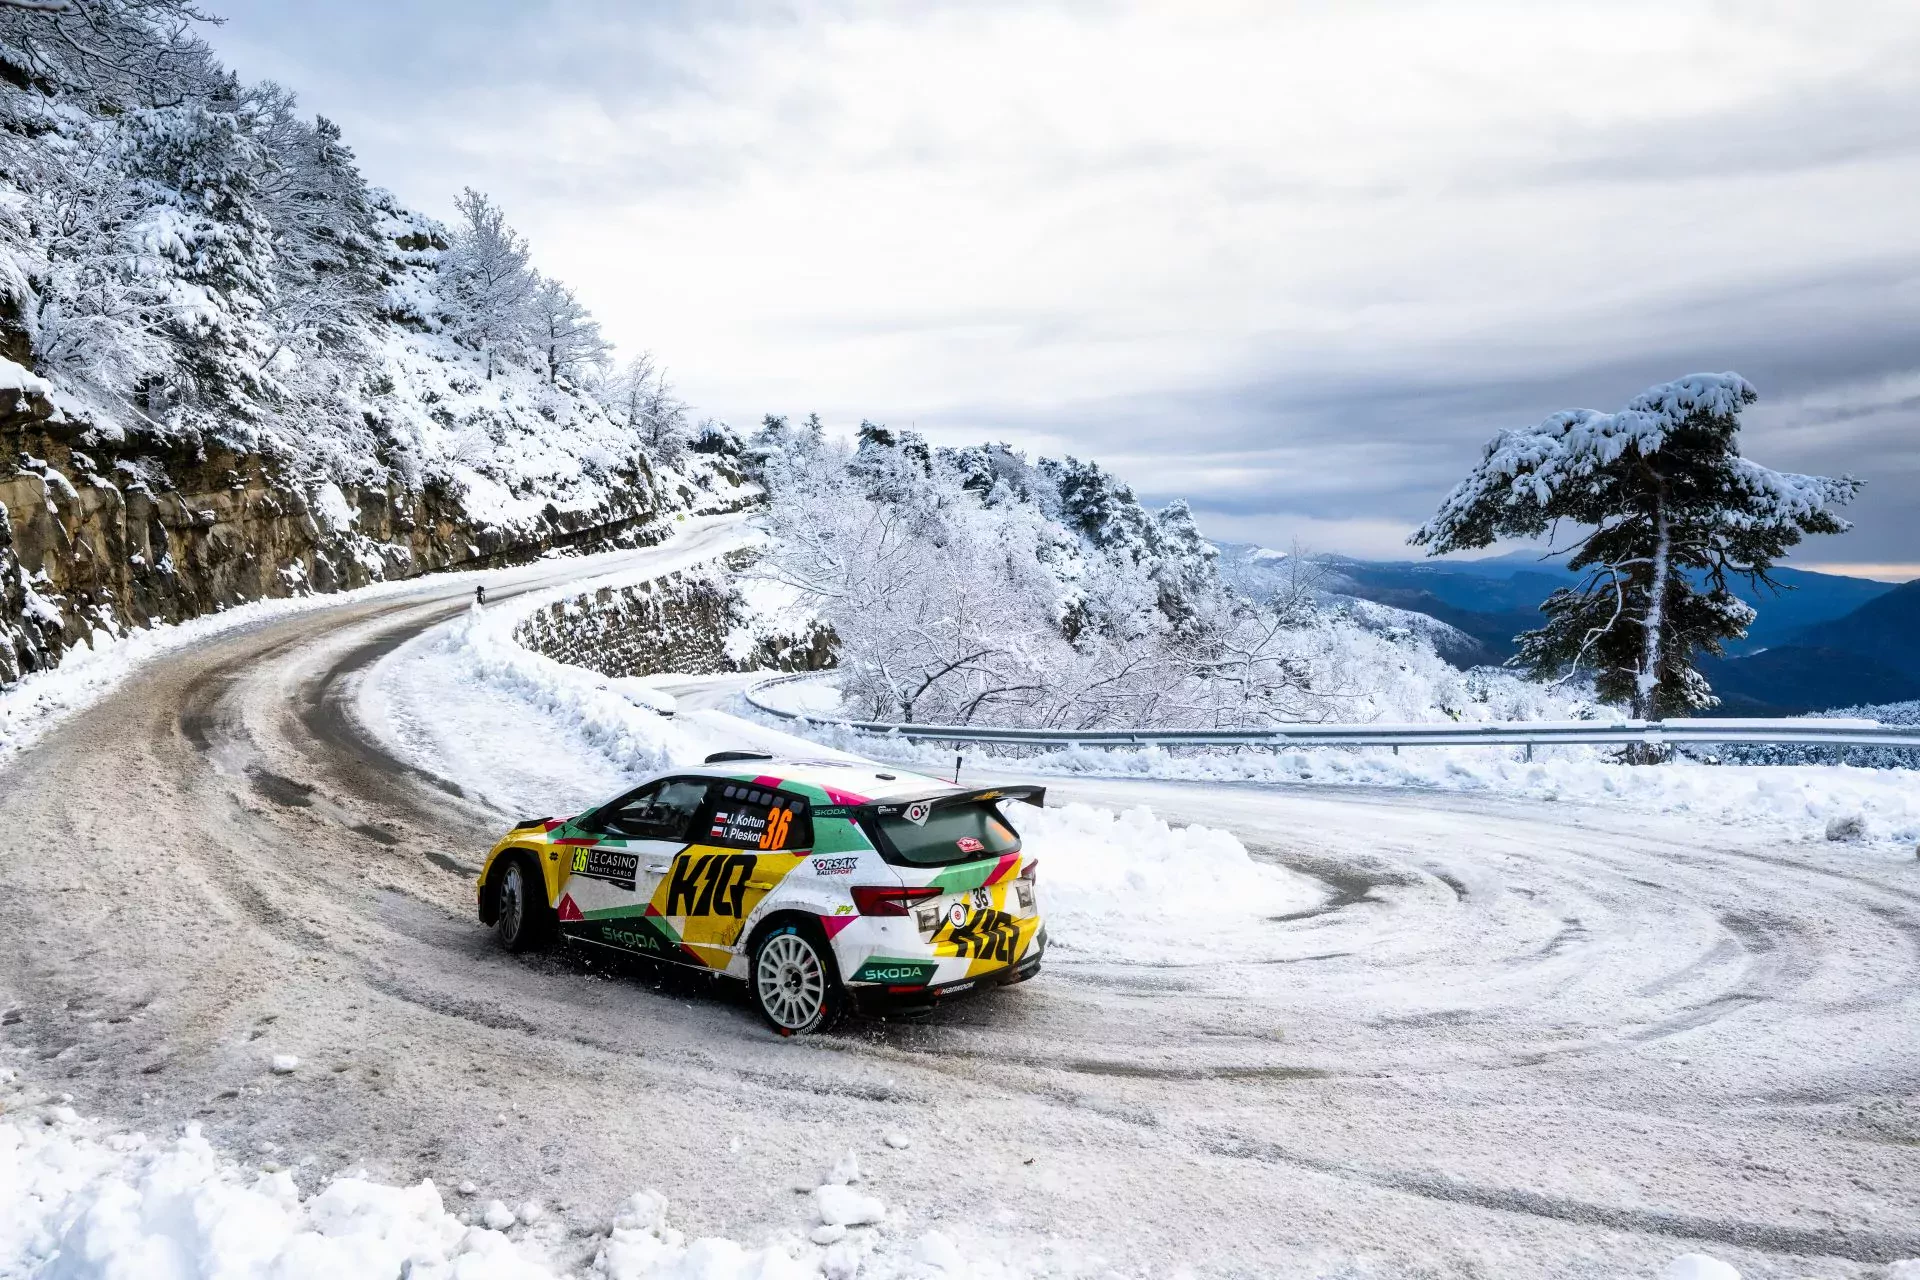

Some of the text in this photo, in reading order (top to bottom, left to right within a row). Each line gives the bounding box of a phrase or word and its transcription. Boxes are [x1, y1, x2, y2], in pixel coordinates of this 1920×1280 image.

[736, 814, 766, 829] Kołtun
[759, 807, 793, 850] 36
[730, 827, 762, 843] Pleskot
[573, 847, 589, 872] 36
[589, 852, 637, 869] LE CASINO
[816, 857, 859, 870] ORSAK
[589, 865, 632, 877] MONTE-CARLO
[817, 868, 853, 876] RALLYSPORT
[972, 887, 989, 909] 36
[865, 967, 922, 980] SKODA
